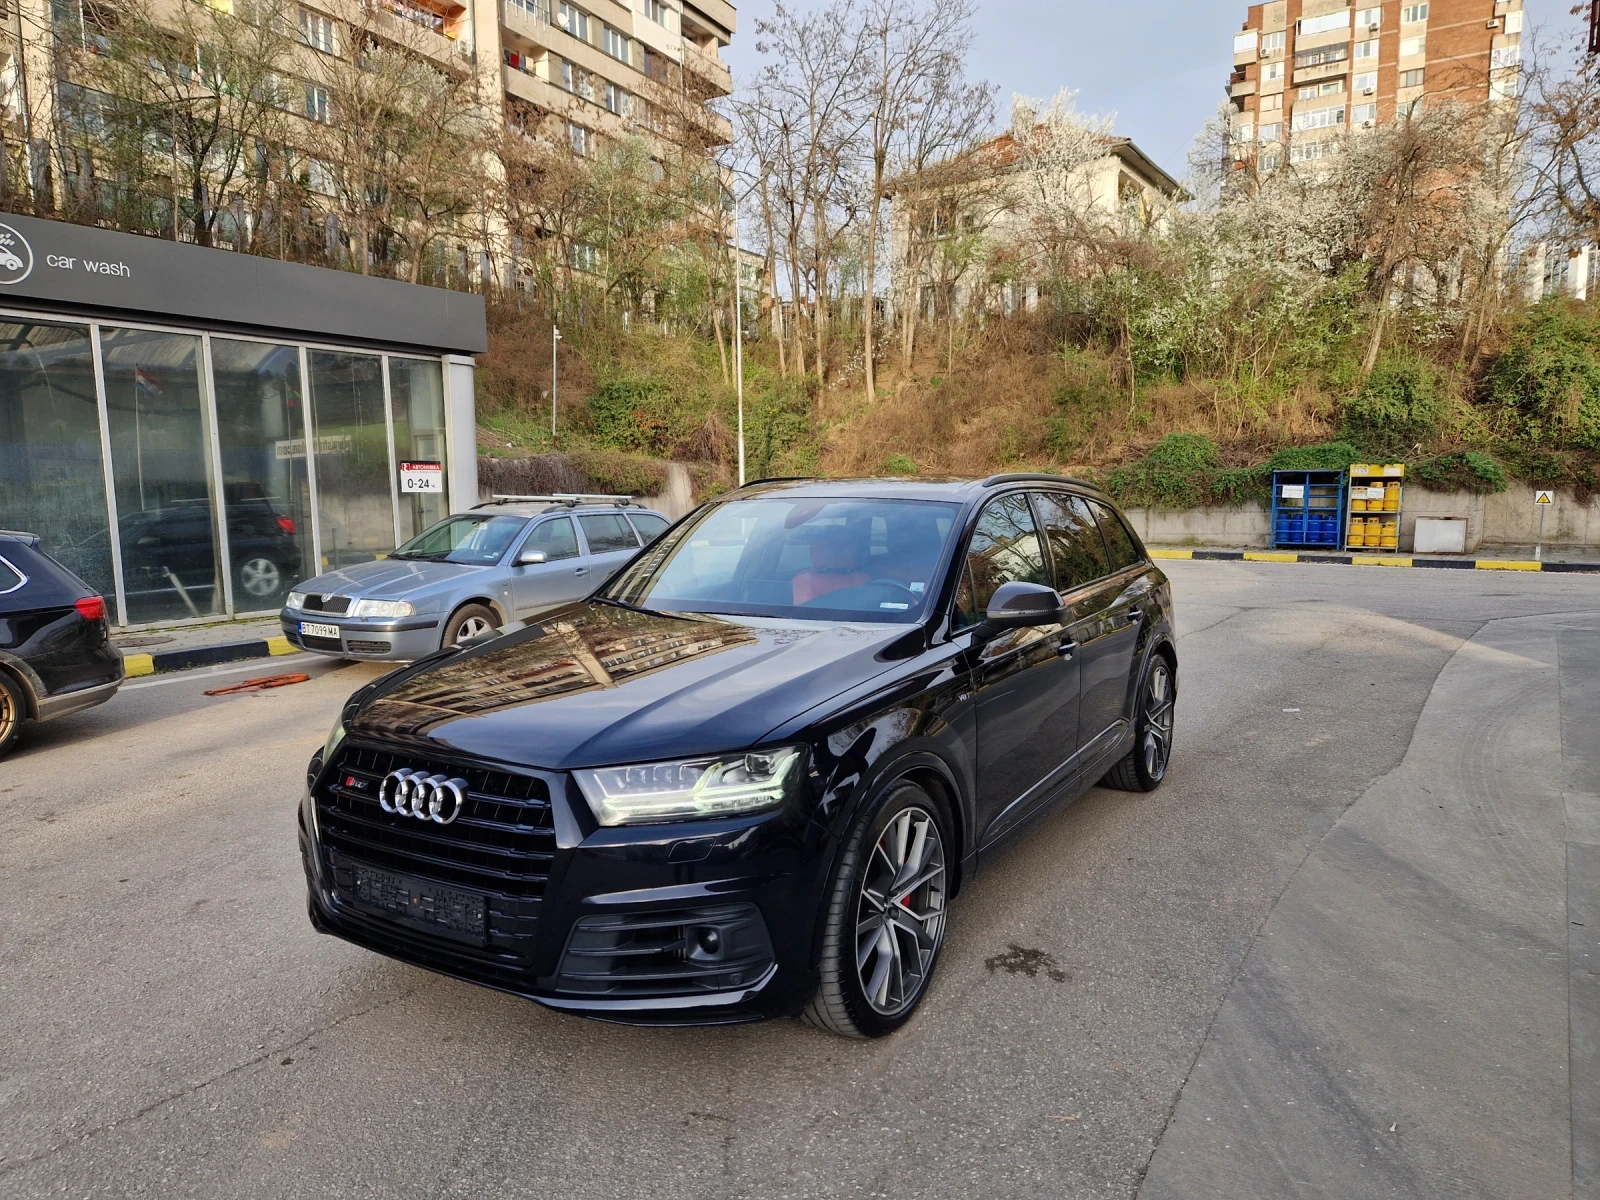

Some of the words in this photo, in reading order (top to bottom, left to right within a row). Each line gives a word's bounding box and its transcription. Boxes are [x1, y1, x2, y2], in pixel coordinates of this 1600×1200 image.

[46, 254, 77, 269] car
[83, 259, 131, 277] wash
[407, 478, 430, 489] 0-24
